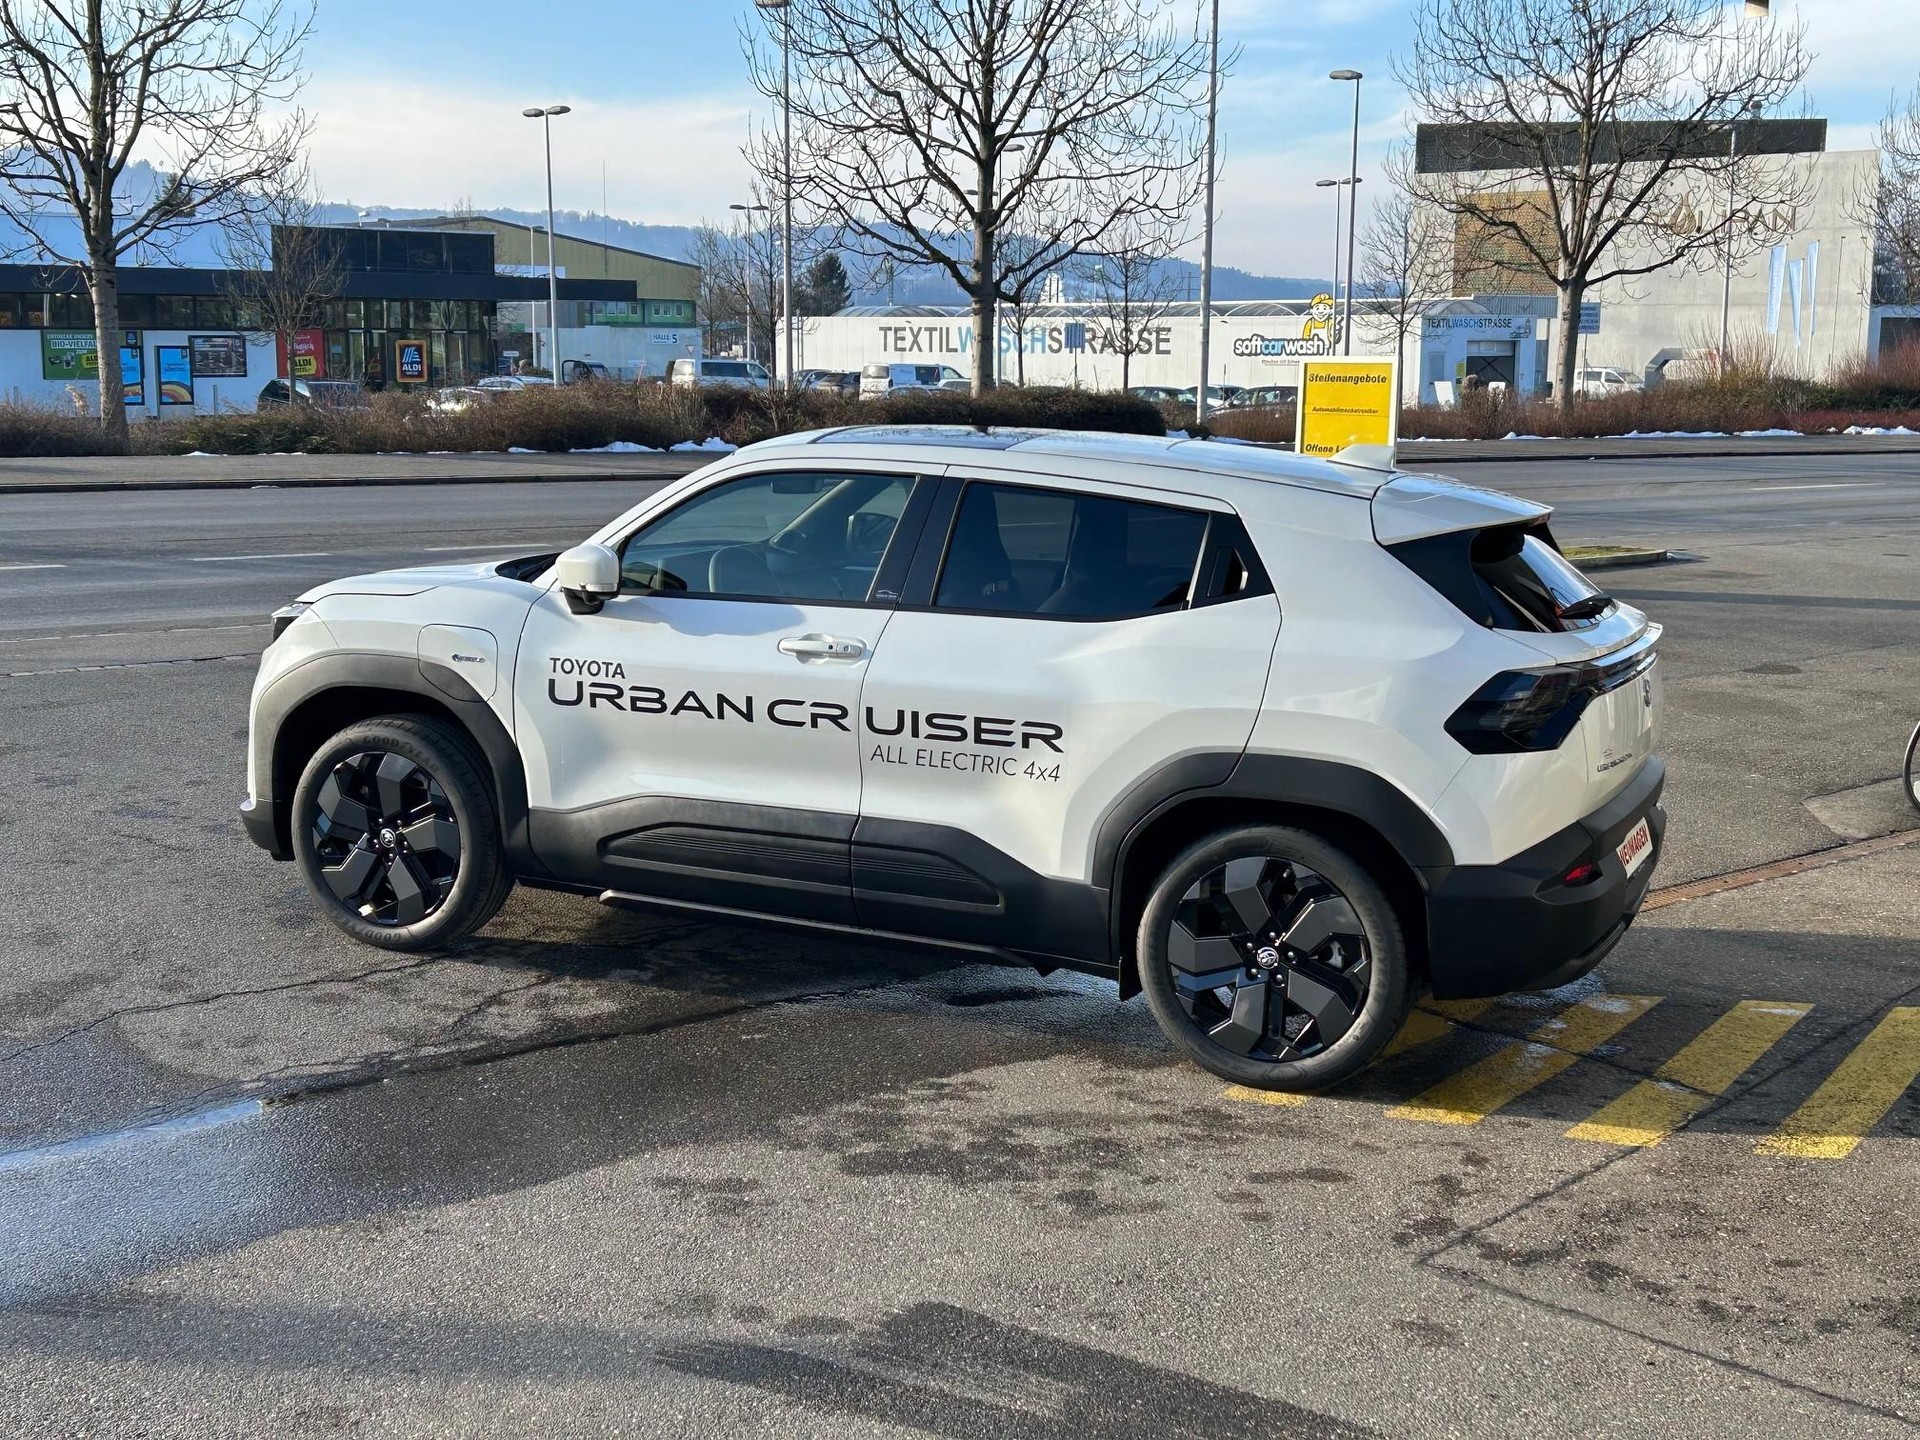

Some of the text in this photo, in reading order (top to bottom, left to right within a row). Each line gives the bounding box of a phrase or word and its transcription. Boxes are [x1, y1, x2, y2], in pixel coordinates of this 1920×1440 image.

[52, 340, 97, 348] BIO-VIELFAL
[879, 326, 1172, 355] TEXTILWSCHSRASSE
[402, 363, 421, 371] ALDI
[1308, 373, 1387, 385] Stellenangebote
[1305, 443, 1334, 453] Offene
[549, 657, 626, 679] TOYOTA
[547, 678, 1064, 753] URBAN CRUISER
[870, 744, 1061, 783] ALL ELECTRIC 4x4
